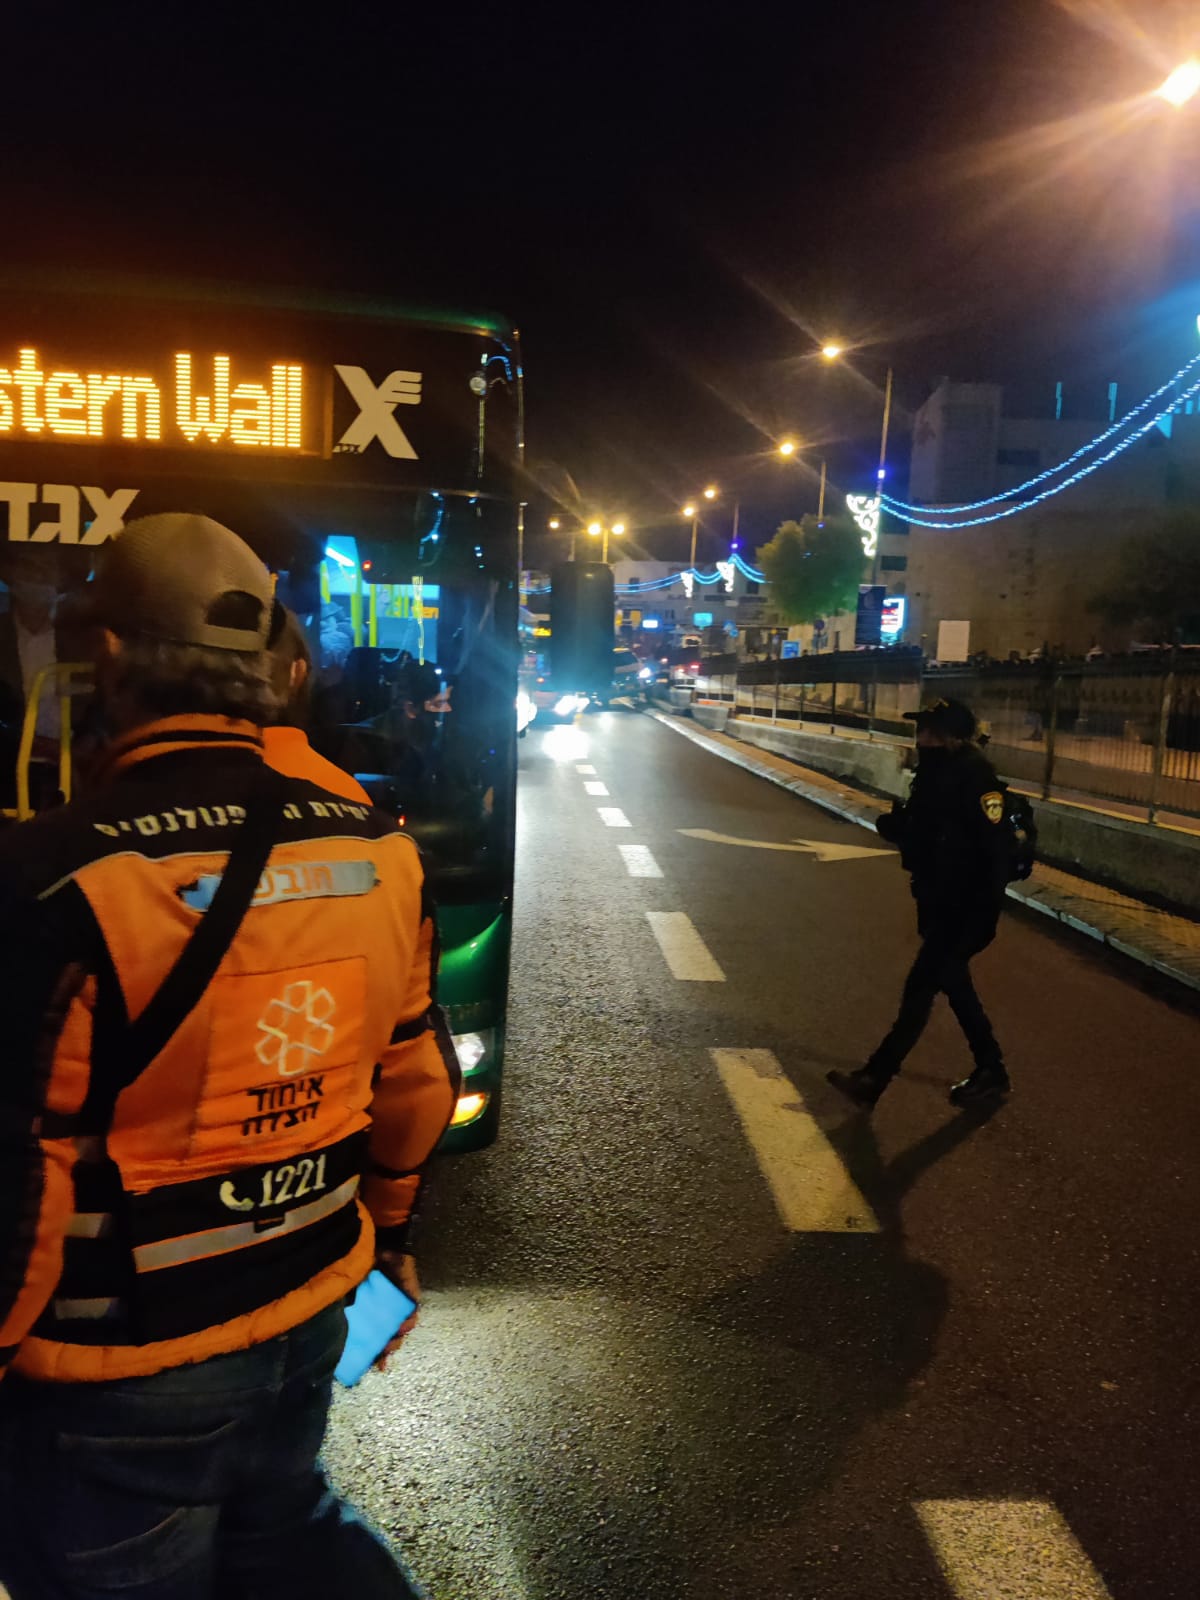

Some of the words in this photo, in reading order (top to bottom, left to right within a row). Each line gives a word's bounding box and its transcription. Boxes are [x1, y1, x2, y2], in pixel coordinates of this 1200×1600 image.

[175, 353, 303, 448] Wall
[246, 1074, 325, 1112] איחוד
[241, 1100, 321, 1136] הצלה
[258, 1153, 326, 1208] 1221
